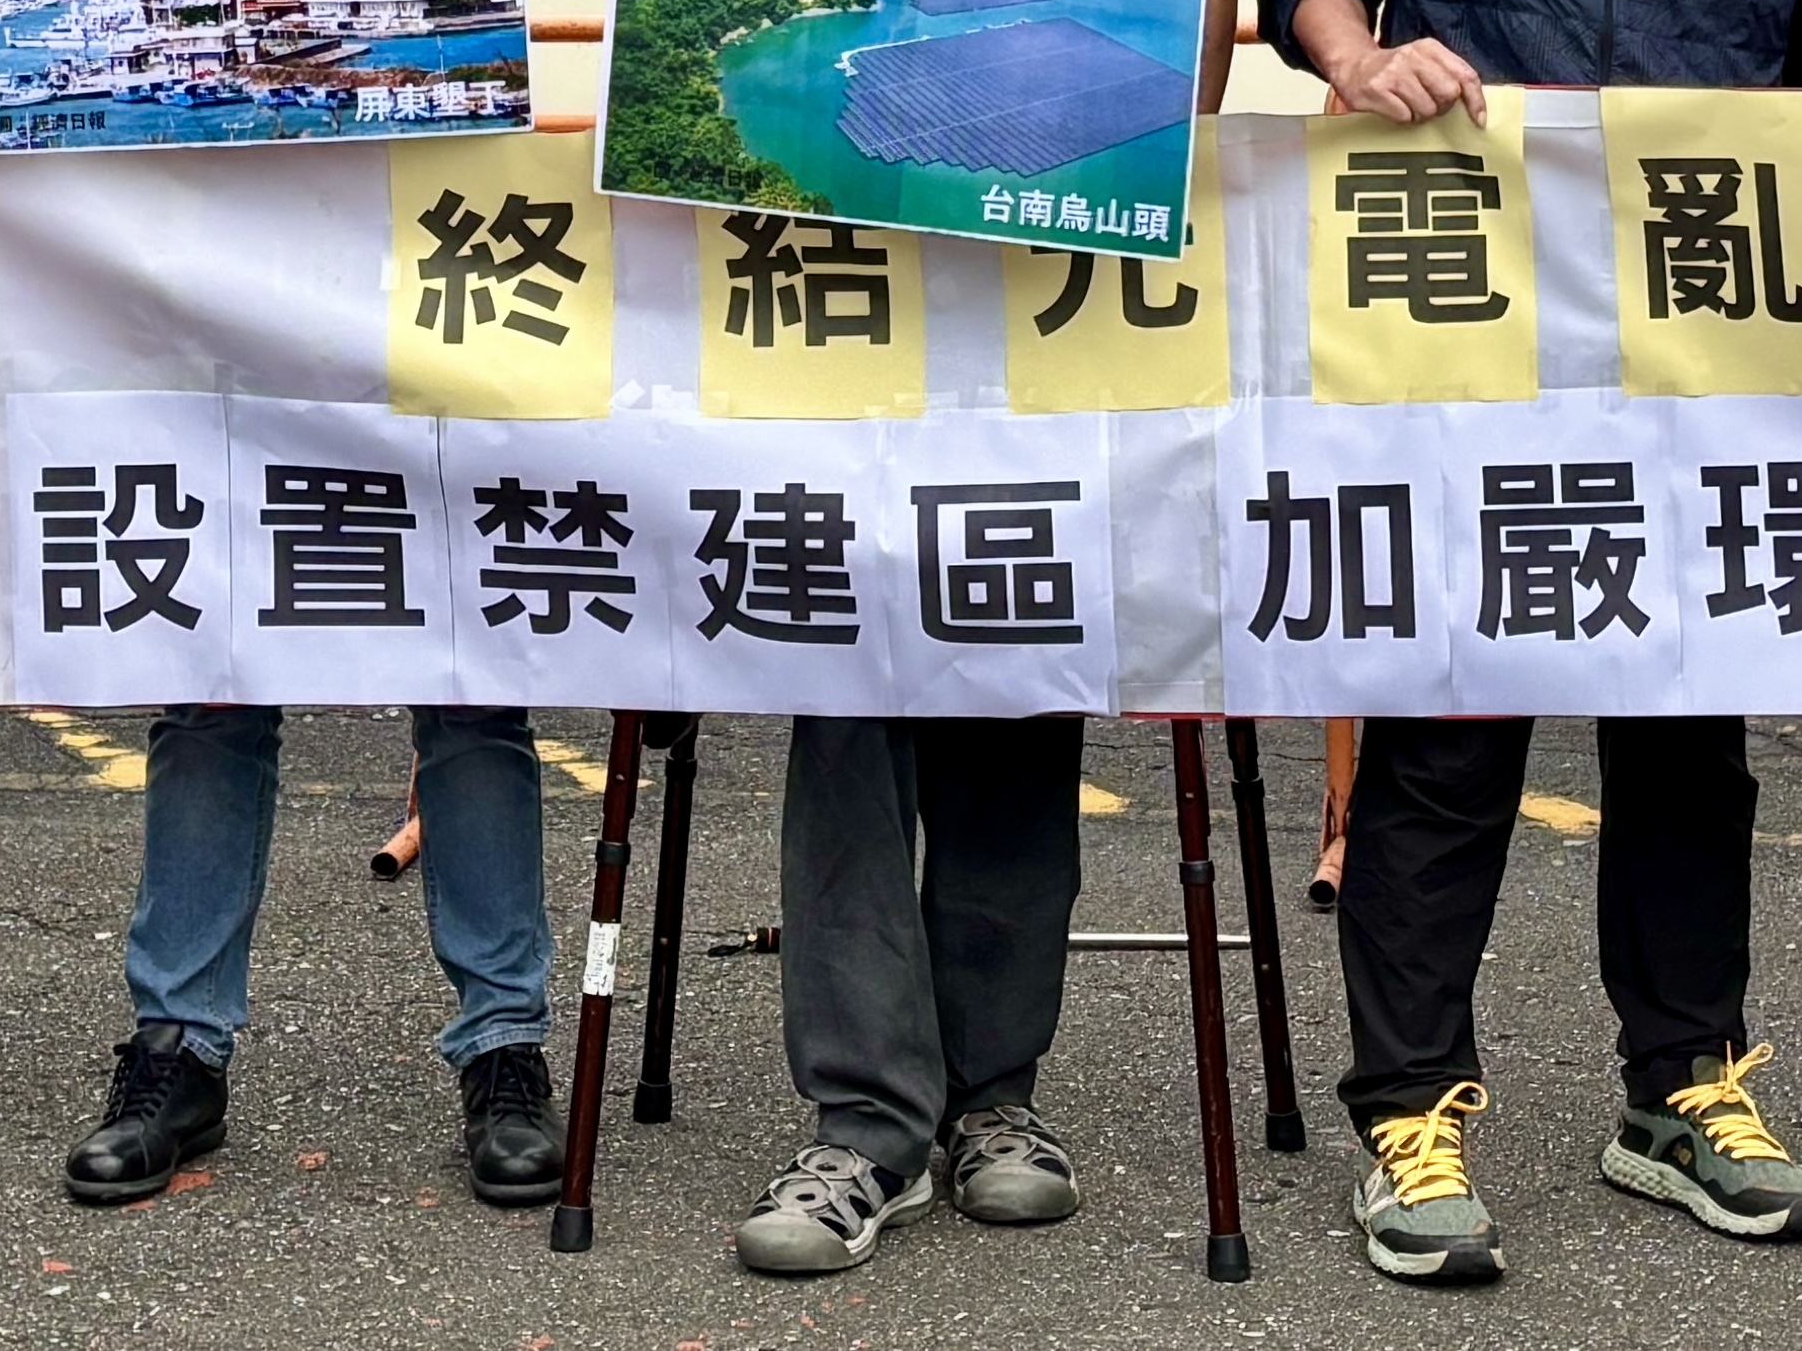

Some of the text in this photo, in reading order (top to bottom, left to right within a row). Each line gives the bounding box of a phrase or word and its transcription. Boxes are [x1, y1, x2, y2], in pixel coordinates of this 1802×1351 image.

[355, 80, 506, 122] 屏東墾丁
[980, 184, 1170, 243] 台南烏山頭
[32, 462, 1085, 646] 設置禁建區
